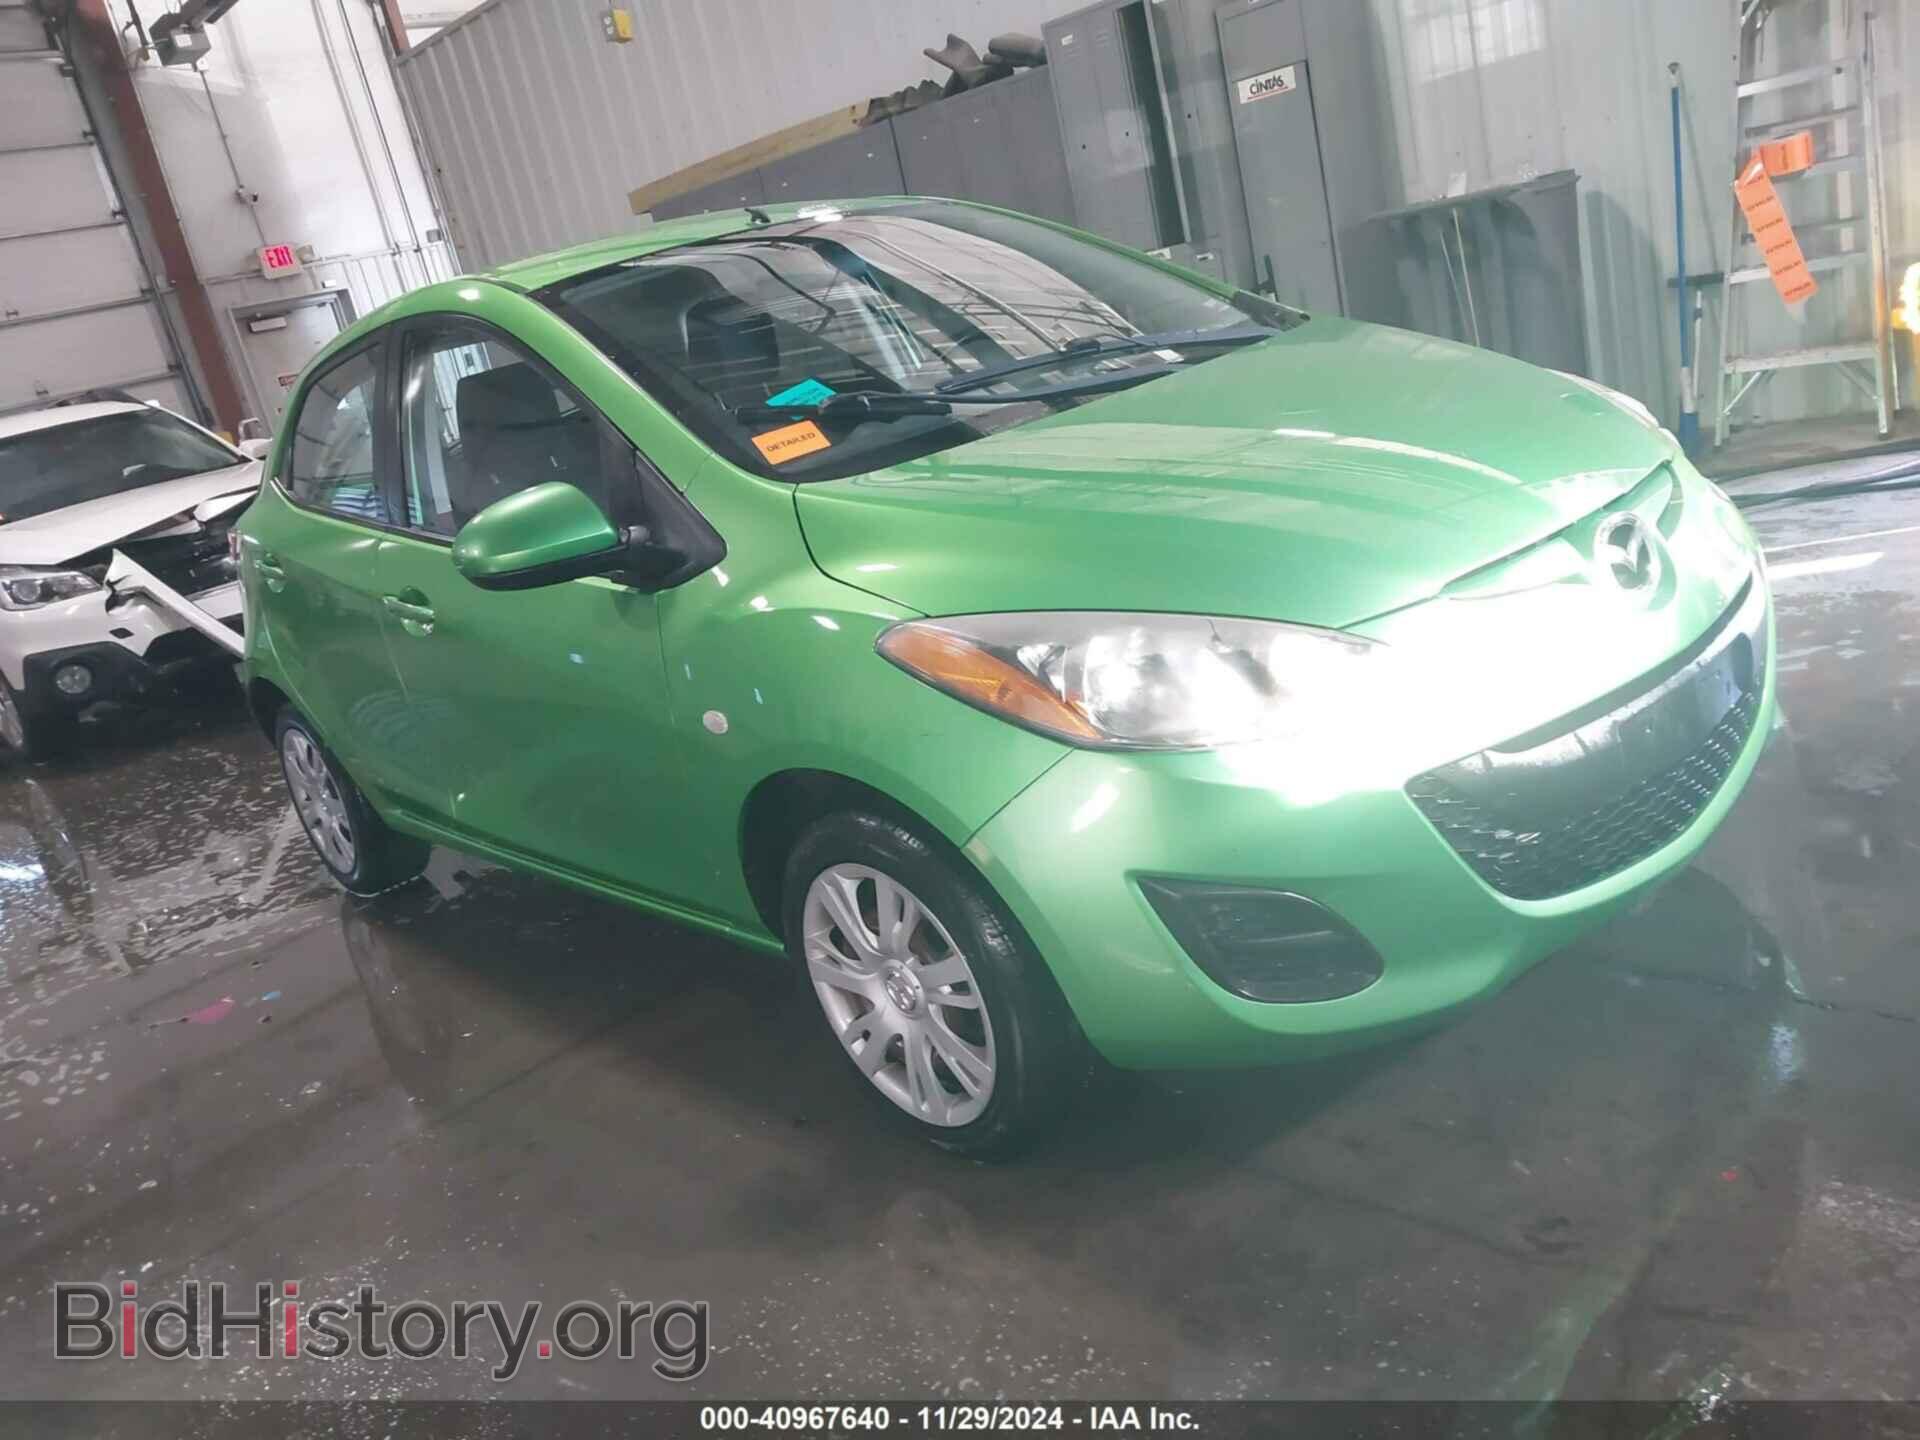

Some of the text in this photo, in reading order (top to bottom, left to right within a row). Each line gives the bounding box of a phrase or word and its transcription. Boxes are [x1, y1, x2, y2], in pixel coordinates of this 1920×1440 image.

[1250, 75, 1285, 95] CINTAS
[265, 246, 293, 268] EXIT
[766, 432, 816, 452] DETAILED
